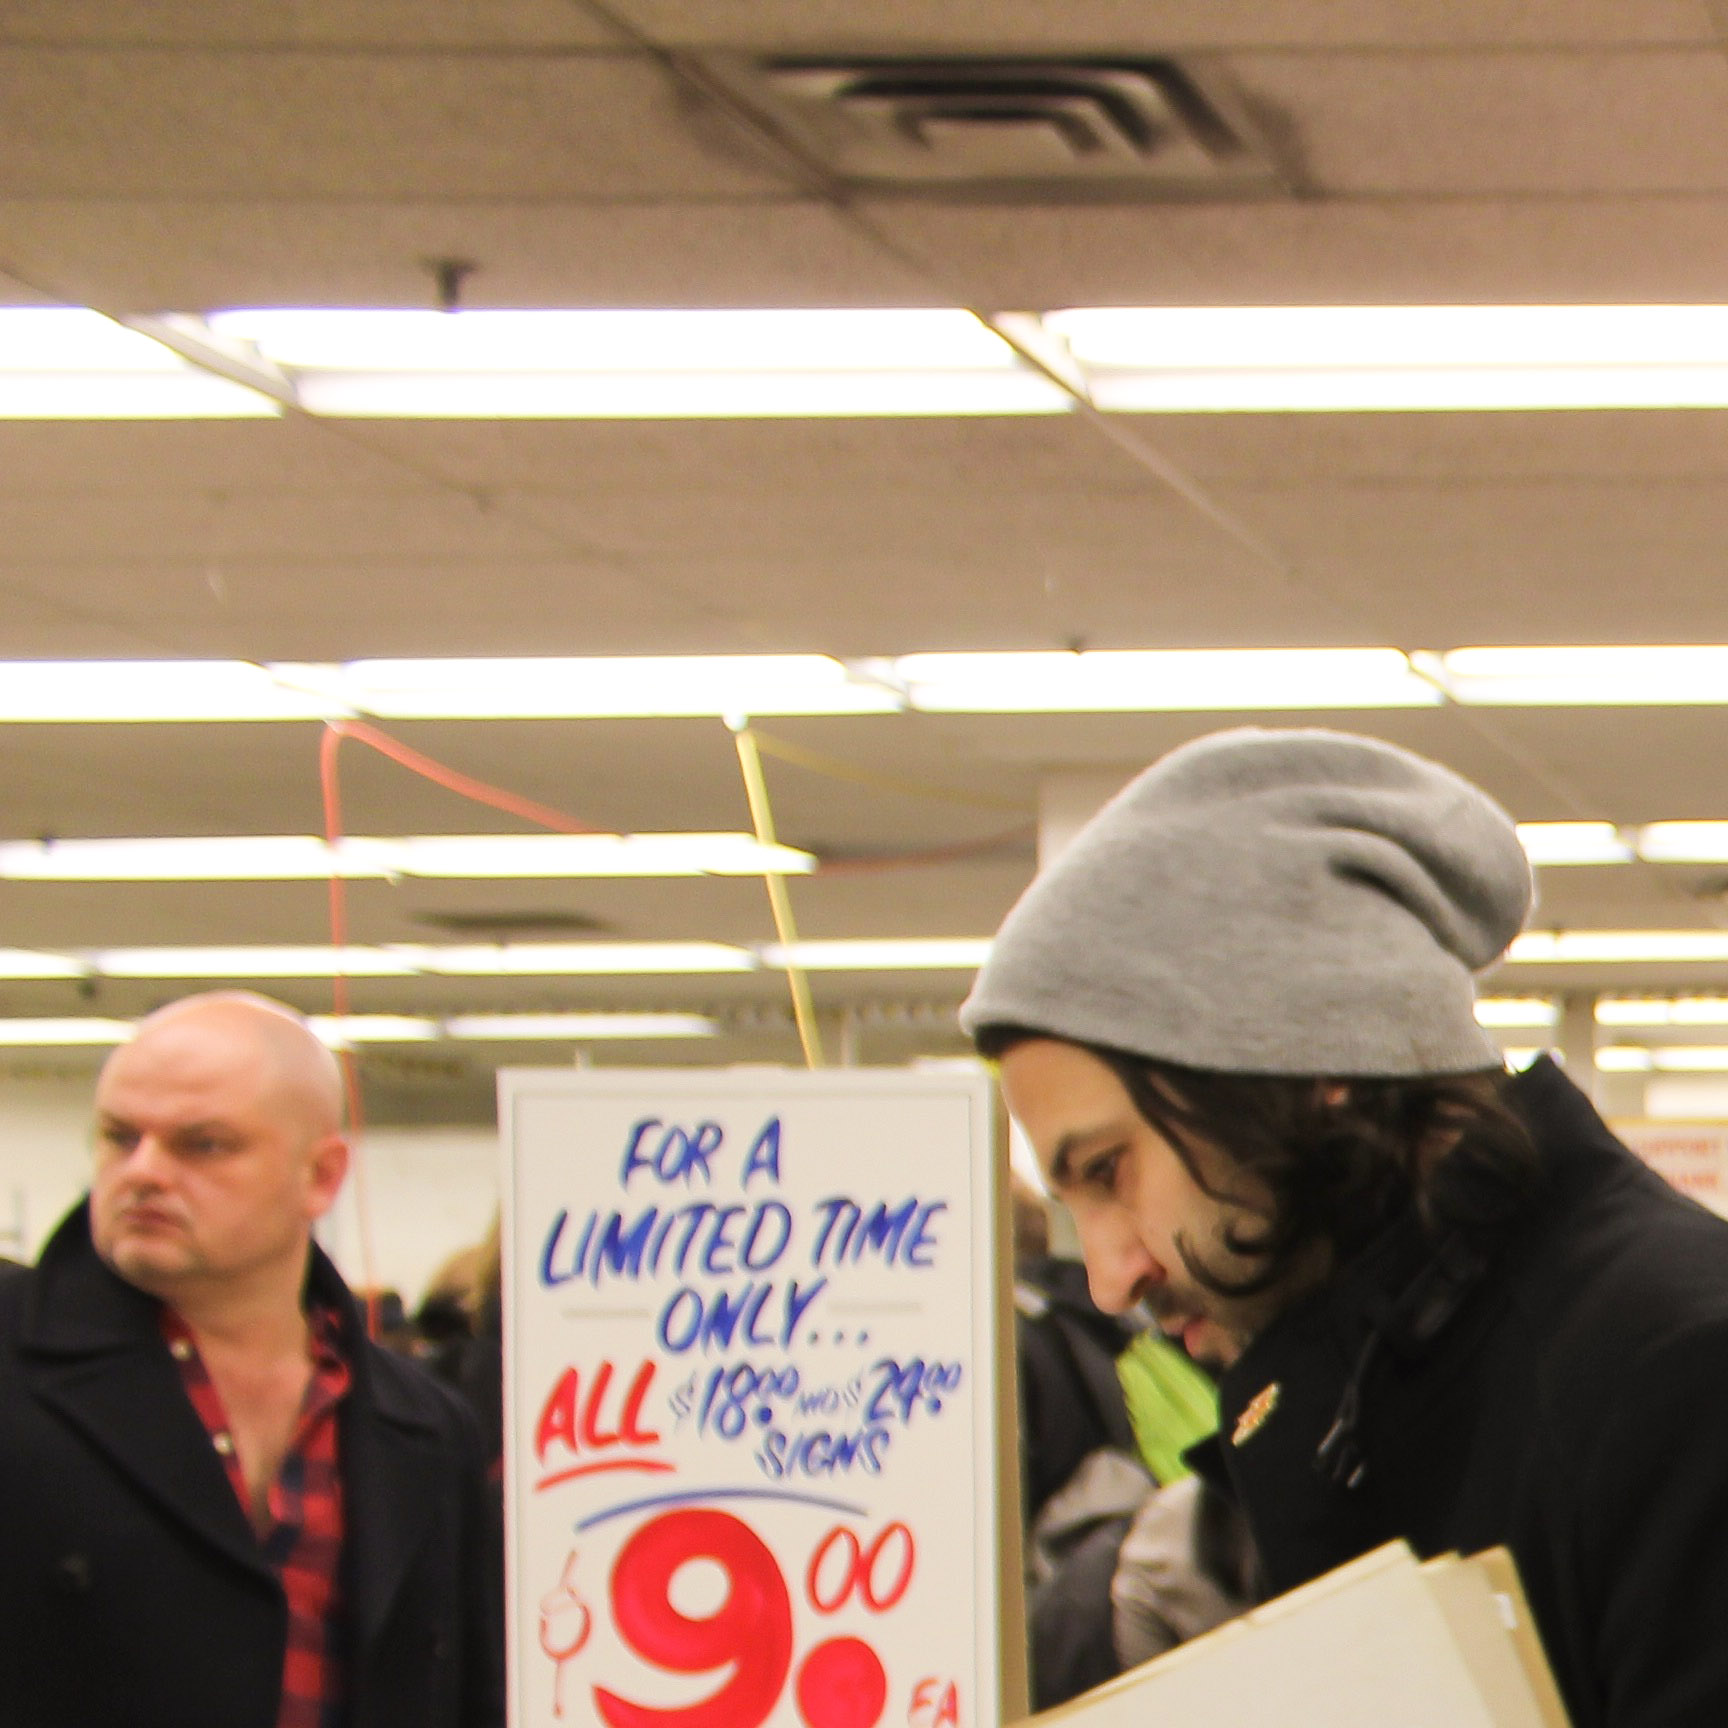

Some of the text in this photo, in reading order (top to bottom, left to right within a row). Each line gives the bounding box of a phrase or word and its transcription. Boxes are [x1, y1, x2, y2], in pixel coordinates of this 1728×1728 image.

[622, 1116, 783, 1189] FOR A
[538, 1196, 948, 1291] LIMITED TIME
[535, 1360, 660, 1464] ALL
[752, 1426, 891, 1480] SIGNS
